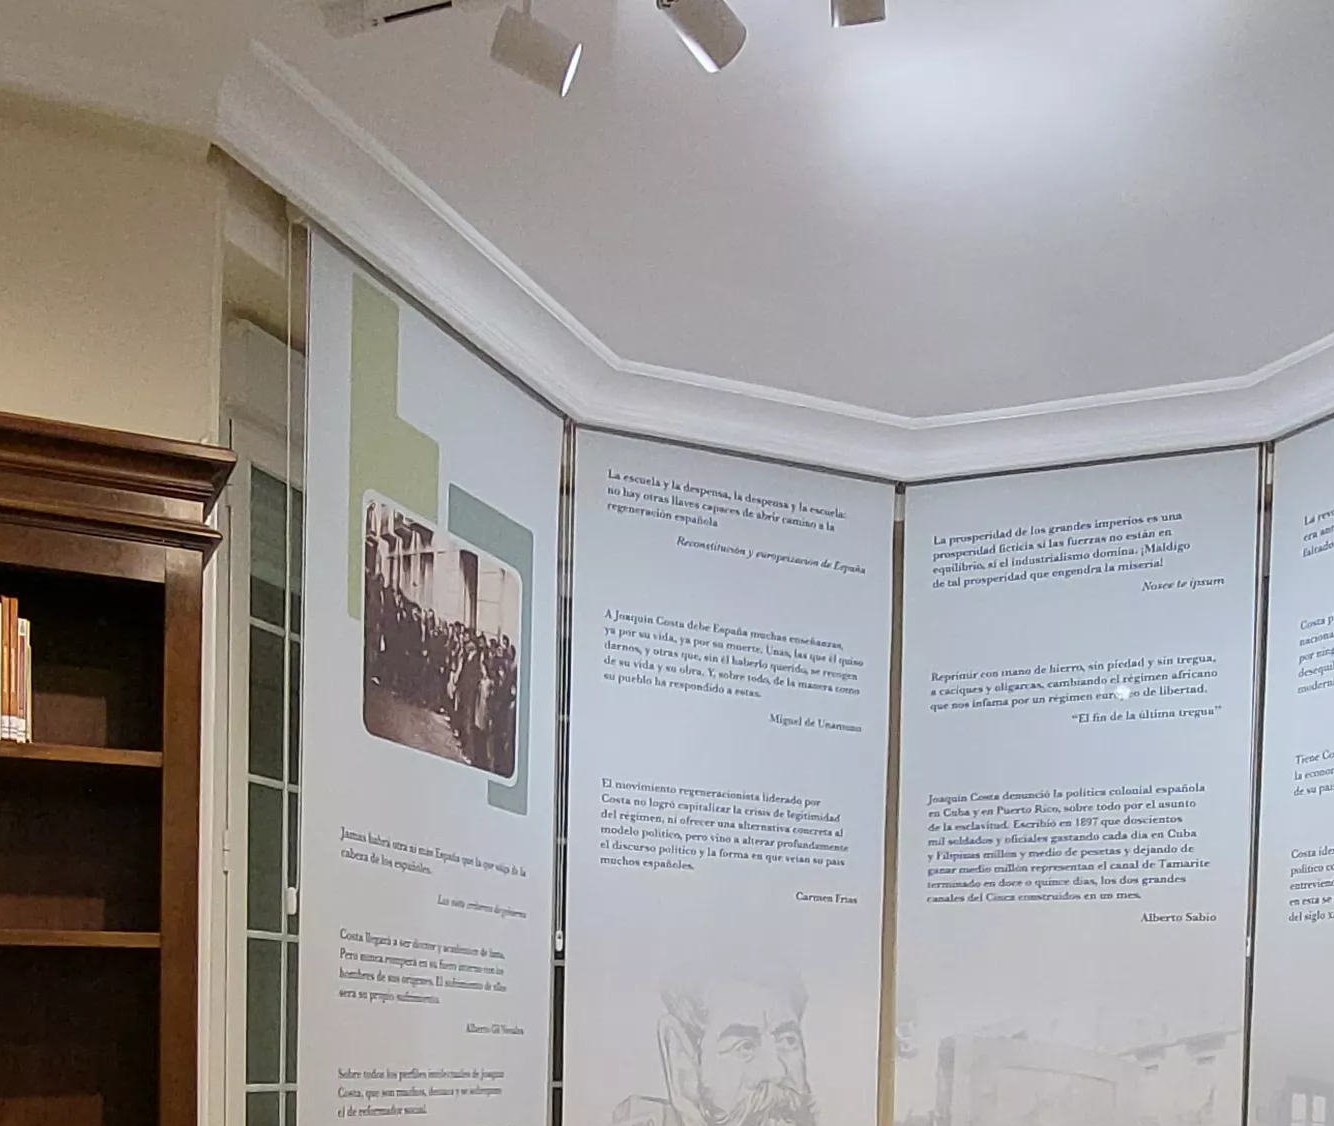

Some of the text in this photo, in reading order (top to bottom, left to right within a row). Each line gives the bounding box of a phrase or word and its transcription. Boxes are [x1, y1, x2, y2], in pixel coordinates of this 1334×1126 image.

[608, 470, 847, 519] La escuela y la despensa, la despensa y la escuela:
[607, 503, 718, 527] regeneración española
[1304, 516, 1316, 526] La
[934, 536, 946, 545] La
[949, 528, 1013, 547] prosperidad
[1015, 527, 1027, 537] de
[1031, 526, 1046, 535] los
[1049, 521, 1092, 536] grandes
[1095, 516, 1144, 530] imperios
[1162, 513, 1183, 521] una
[1142, 578, 1225, 592] Nosce te ipsum
[604, 609, 612, 618] A
[613, 611, 654, 625] Joaquín
[656, 616, 685, 628] Costa
[687, 620, 711, 632] debe
[713, 623, 749, 637] España
[750, 631, 788, 642] muchas
[1300, 618, 1326, 630] Costa
[932, 671, 978, 684] Reprimir
[1001, 669, 1032, 677] mano
[1034, 665, 1047, 675] de
[1088, 661, 1105, 670] sin
[1107, 658, 1145, 672] piedad
[1148, 660, 1154, 669] y
[1157, 658, 1174, 666] sin
[769, 713, 863, 732] Miguel de Unamuno
[1093, 713, 1107, 722] fin
[1110, 711, 1123, 721] de
[1126, 711, 1136, 720] la
[1139, 709, 1176, 719] última
[602, 778, 821, 808] El movimiento regeneracionista liderado por
[929, 794, 968, 806] Joaquín
[970, 792, 1000, 801] Costa
[1053, 789, 1063, 798] la
[1066, 787, 1107, 801] política
[1109, 785, 1153, 796] colonial
[1156, 783, 1206, 796] española
[600, 856, 641, 866] muchos
[1291, 849, 1317, 859] Costa
[796, 891, 833, 903] Carmen
[1141, 912, 1217, 922] Alberto Sabio
[339, 929, 364, 942] Costa
